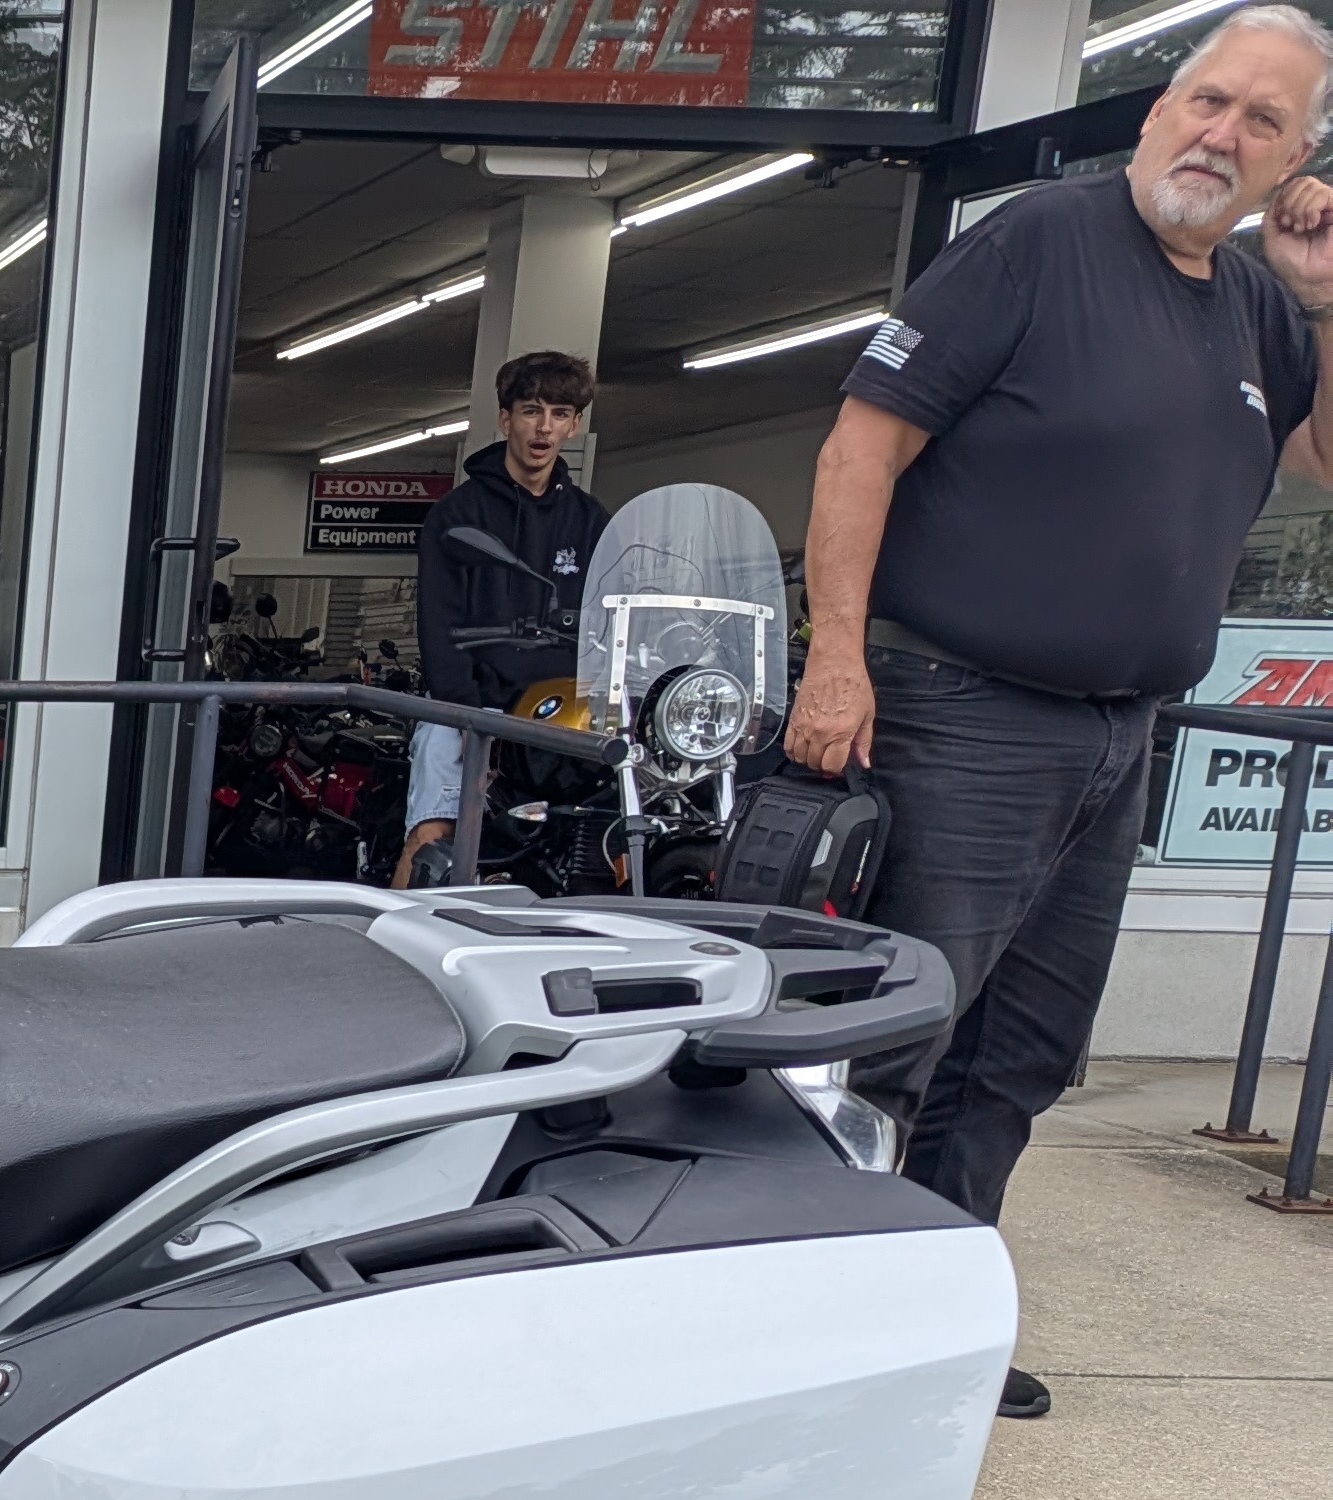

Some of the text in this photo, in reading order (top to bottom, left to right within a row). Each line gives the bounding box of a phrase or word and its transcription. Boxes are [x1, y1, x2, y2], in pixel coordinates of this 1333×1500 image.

[382, 0, 724, 74] STIHL
[322, 480, 430, 497] HONDA
[319, 504, 380, 520] Power
[317, 528, 417, 546] Equipment
